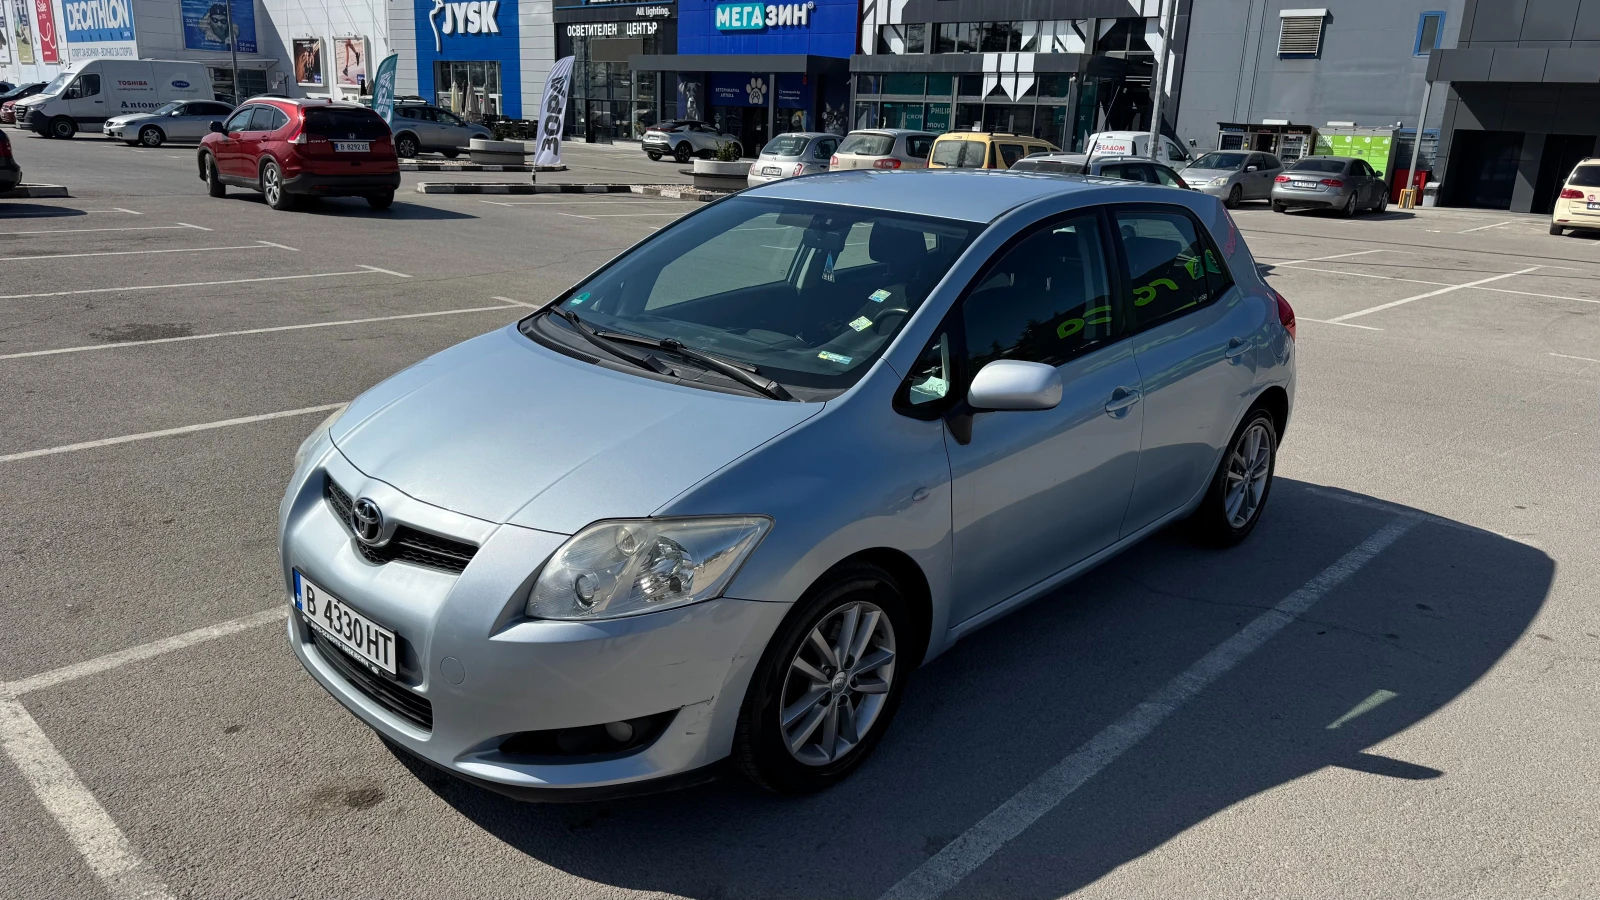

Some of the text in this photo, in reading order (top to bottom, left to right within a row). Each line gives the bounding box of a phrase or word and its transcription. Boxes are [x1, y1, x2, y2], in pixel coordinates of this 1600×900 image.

[66, 0, 130, 31] DECATHLON
[442, 1, 500, 34] JYSK
[636, 7, 645, 16] All
[716, 3, 808, 27] МЕГАЗИН
[567, 21, 658, 37] ОСВЕТИТЕЛЕН ЦЕНТЪР
